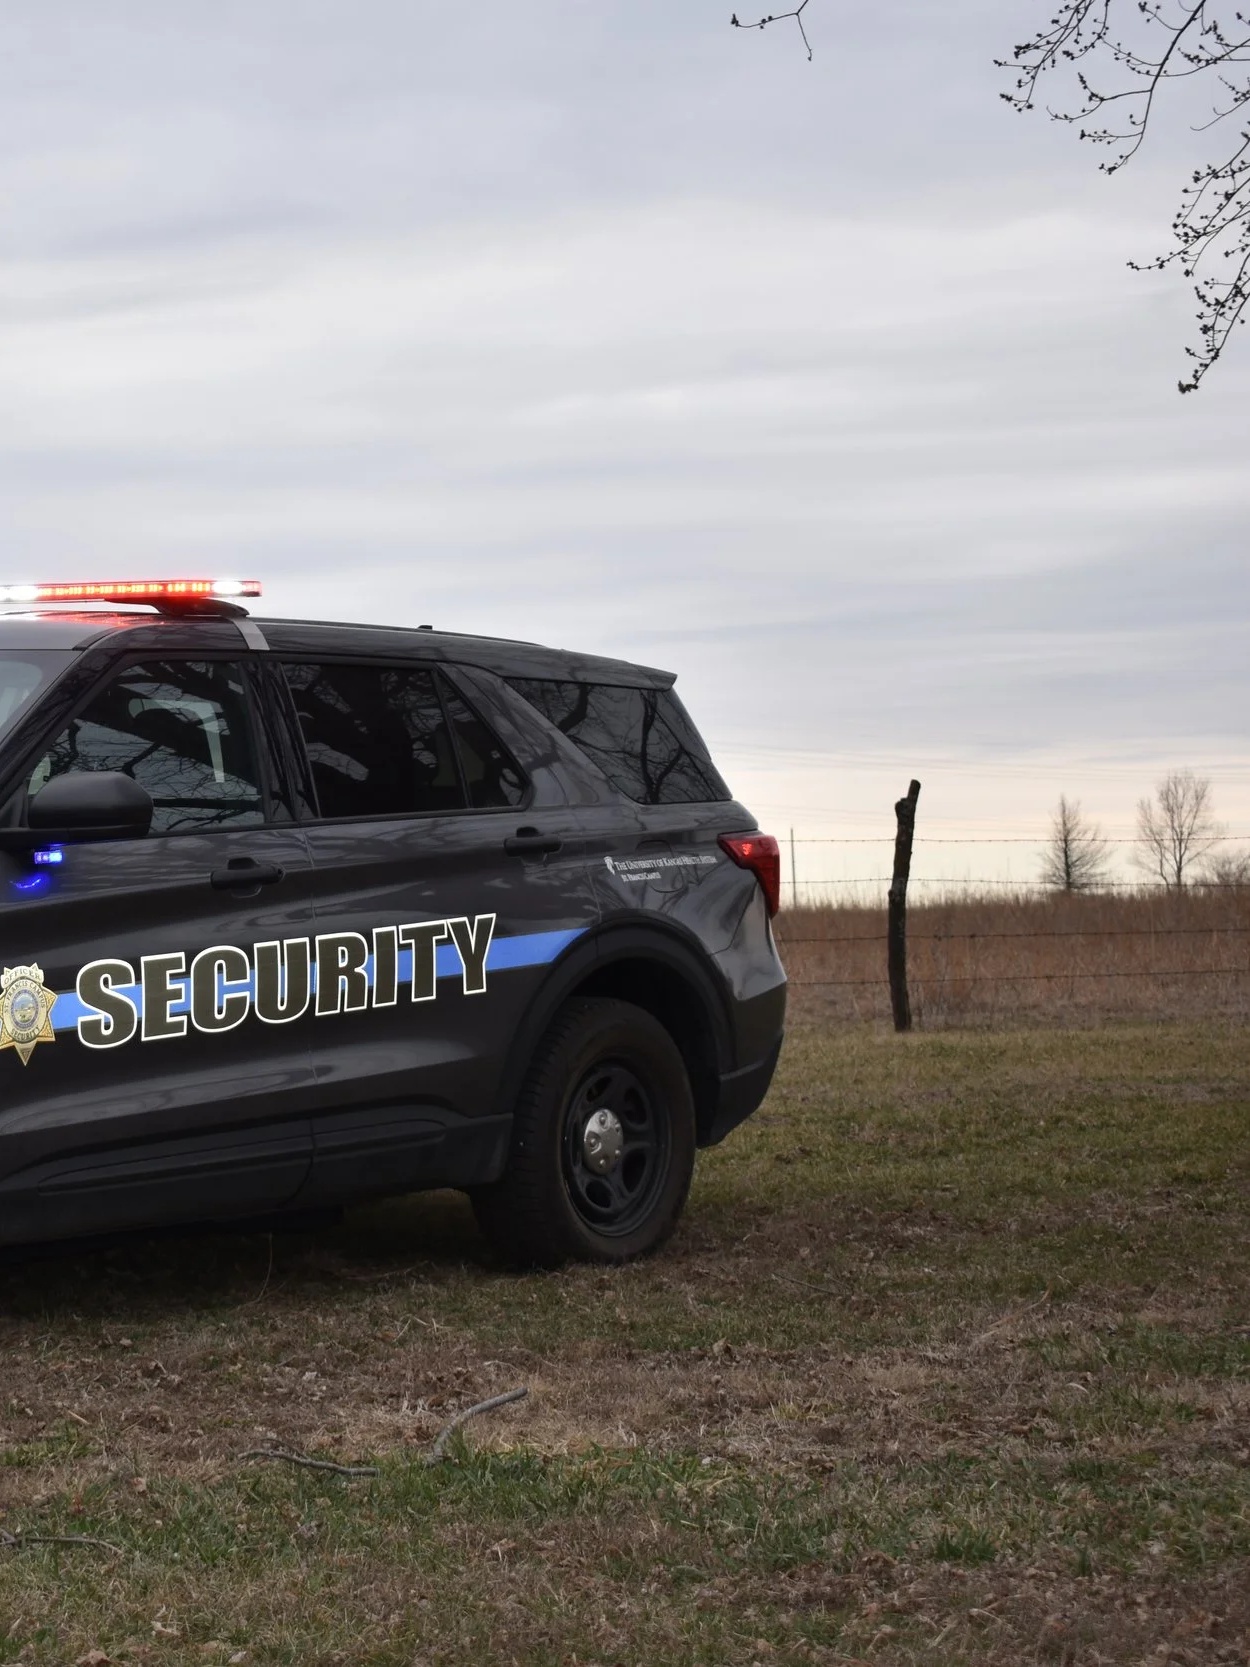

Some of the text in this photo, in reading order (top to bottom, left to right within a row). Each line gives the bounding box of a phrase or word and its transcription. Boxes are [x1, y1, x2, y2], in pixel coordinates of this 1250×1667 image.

[4, 968, 41, 985] OFFICER
[76, 913, 496, 1049] SECURITY
[6, 980, 28, 1001] FRANCIS
[30, 981, 46, 1009] CAMPUS
[11, 1025, 40, 1041] SECURITY
